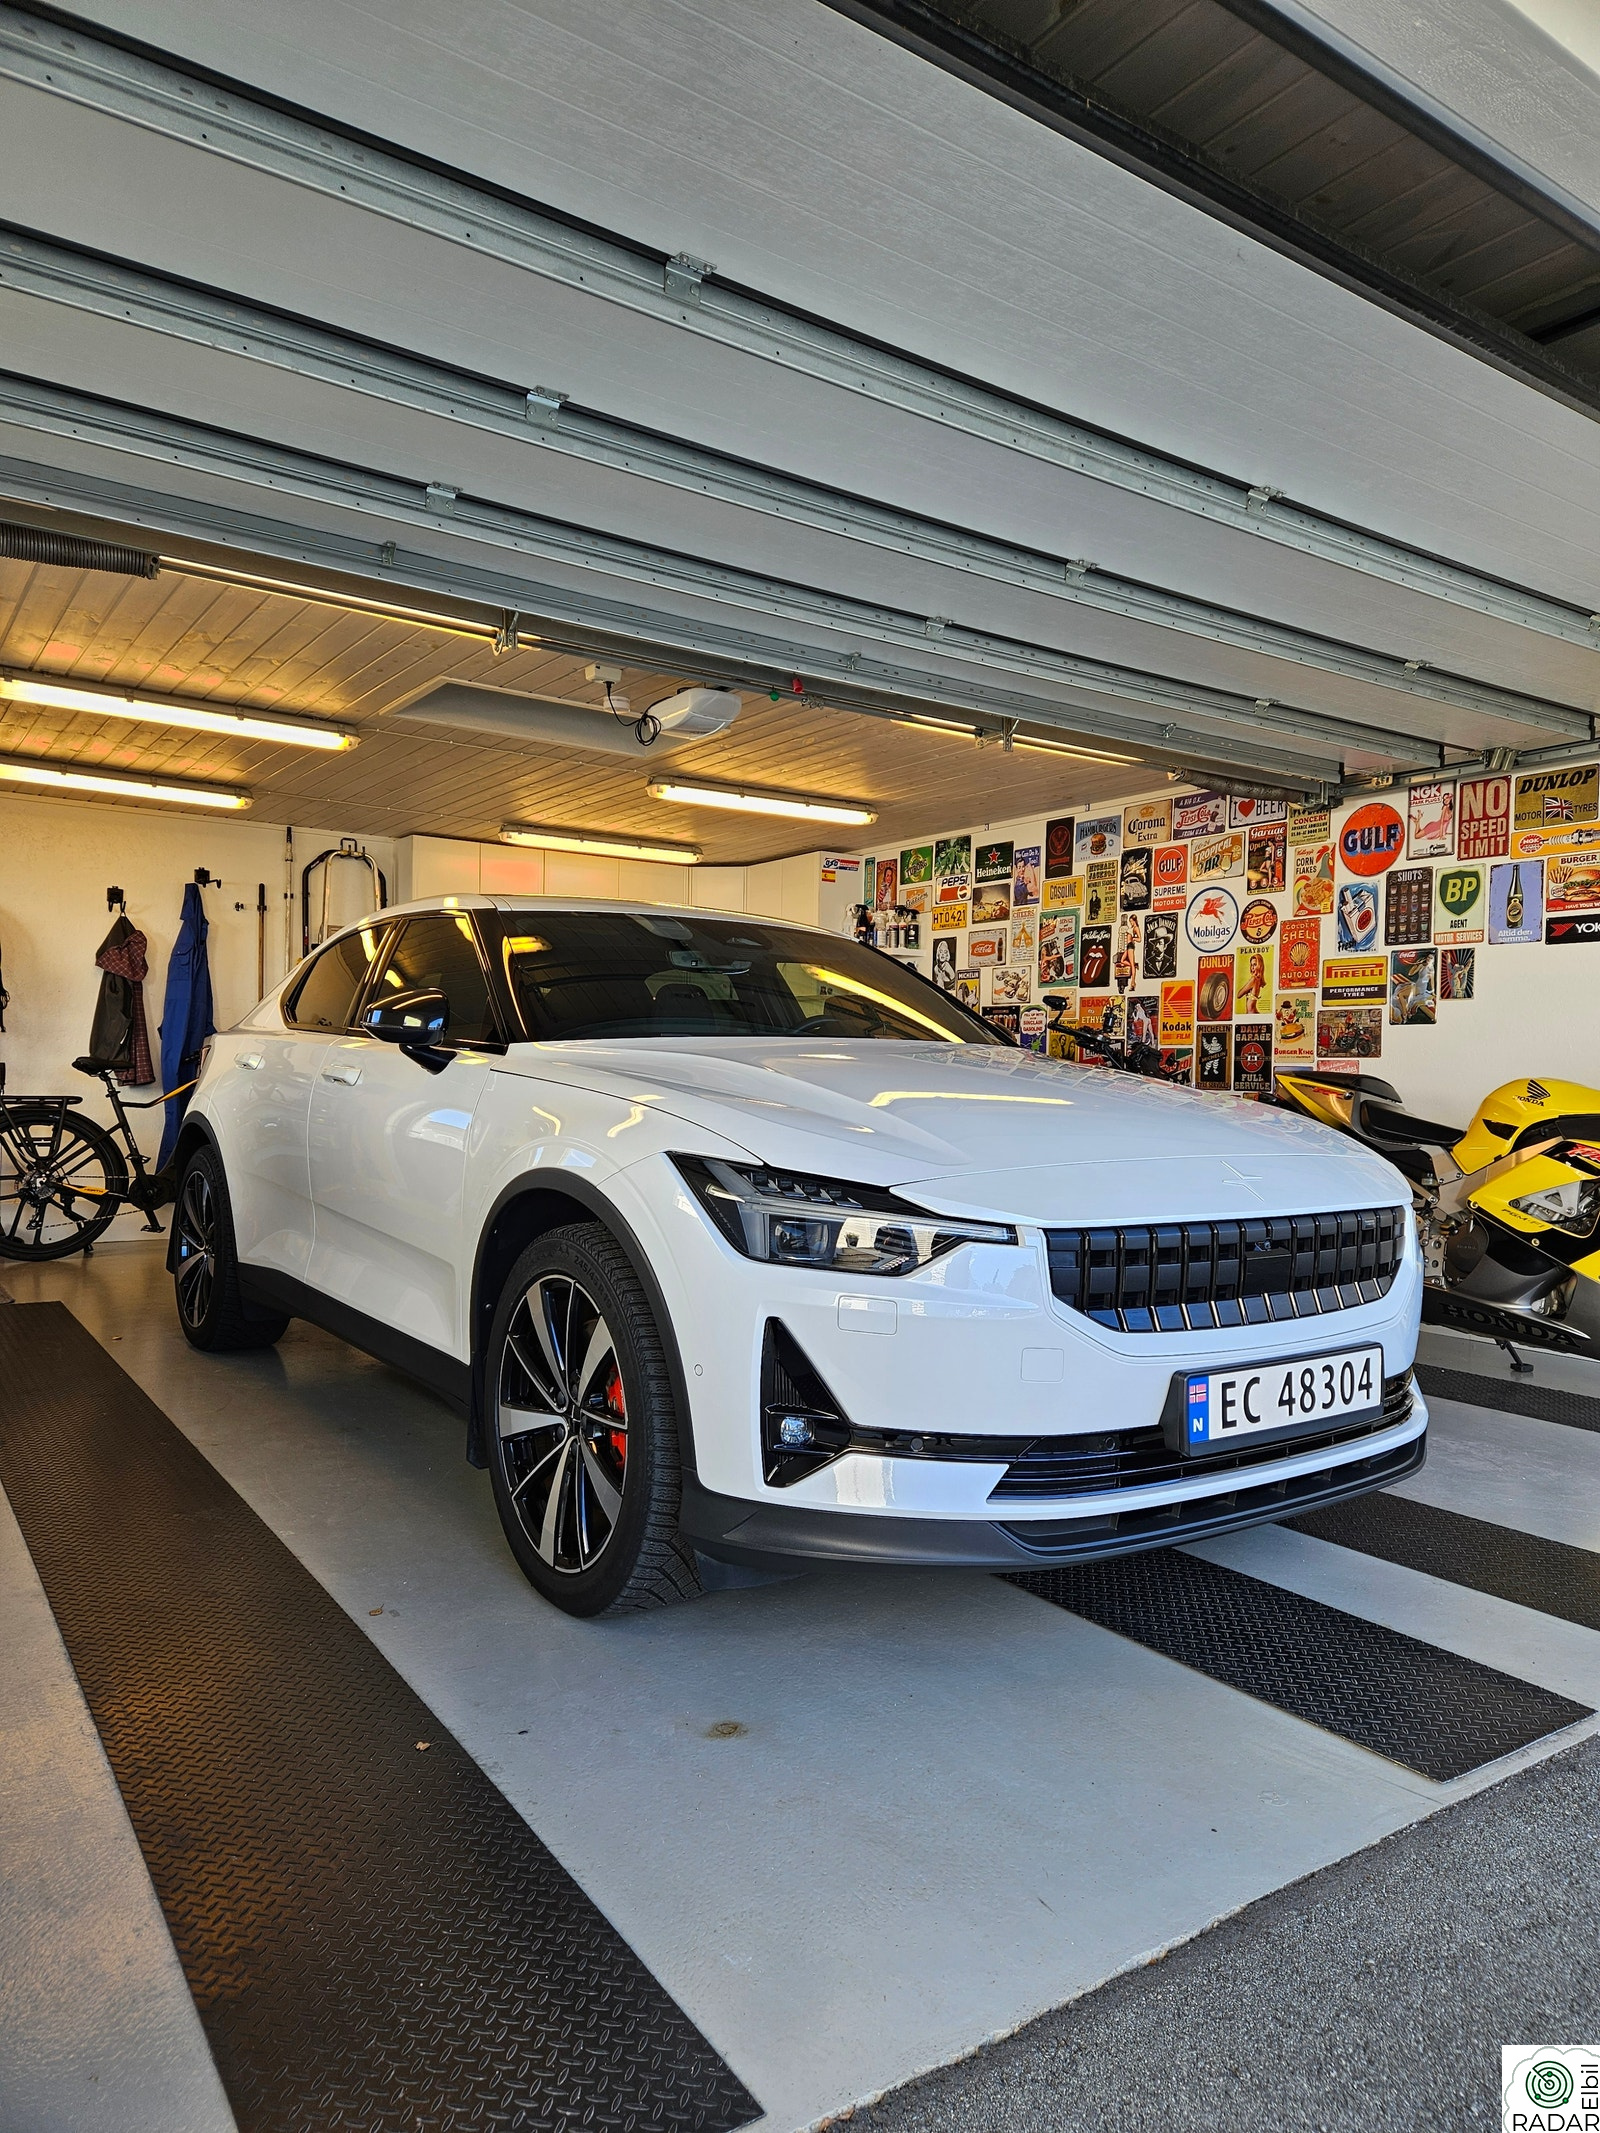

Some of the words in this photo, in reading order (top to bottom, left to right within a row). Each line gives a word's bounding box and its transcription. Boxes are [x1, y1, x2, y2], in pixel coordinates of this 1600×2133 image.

[1518, 768, 1596, 794] DUNLOP
[1410, 784, 1441, 800] NGK
[1462, 778, 1508, 820] NO
[1233, 801, 1237, 820] I
[1256, 800, 1283, 816] BEER
[1515, 810, 1542, 821] MOTOR
[1574, 802, 1598, 814] TYRES
[1294, 814, 1327, 825] CONCERT
[1128, 818, 1165, 835] Corona
[1251, 827, 1285, 839] Garage
[1461, 817, 1507, 840] SPEED
[1137, 832, 1158, 842] Extra
[1344, 823, 1400, 857] GULF
[1194, 837, 1232, 863] TROPICAL
[1460, 836, 1506, 859] LIMIT
[1159, 858, 1183, 872] GULF
[1196, 854, 1220, 876] BAR
[1297, 856, 1314, 866] CORN
[1560, 854, 1597, 865] BURGER
[976, 865, 1012, 878] Heineken
[1296, 864, 1317, 875] FLAKES
[1397, 870, 1423, 882] SHOTS
[941, 875, 968, 887] PEPSI
[1050, 882, 1076, 900] GASOLINE
[1154, 885, 1185, 897] SUPREME
[1445, 877, 1478, 903] BP
[1147, 921, 1159, 934] JACK
[1449, 919, 1467, 929] AGENT
[1193, 925, 1231, 939] Mobilgas
[1282, 930, 1318, 943] SHELL
[1435, 932, 1454, 943] MOTOR
[1456, 930, 1483, 941] SERVICES
[1200, 955, 1233, 968] DUNLOP
[958, 971, 979, 979] MICHELIN
[1326, 962, 1384, 979] PIRELLI
[1162, 1022, 1191, 1031] Kodak
[1240, 1025, 1267, 1033] DAD'S
[1201, 1052, 1226, 1063] MICHELIN
[1235, 1082, 1270, 1090] SERVICE
[1512, 1095, 1545, 1107] HONDA
[1439, 1301, 1581, 1349] HONDA
[1221, 1376, 1261, 1429] EC
[1278, 1357, 1373, 1417] 48304
[1193, 1417, 1203, 1433] N
